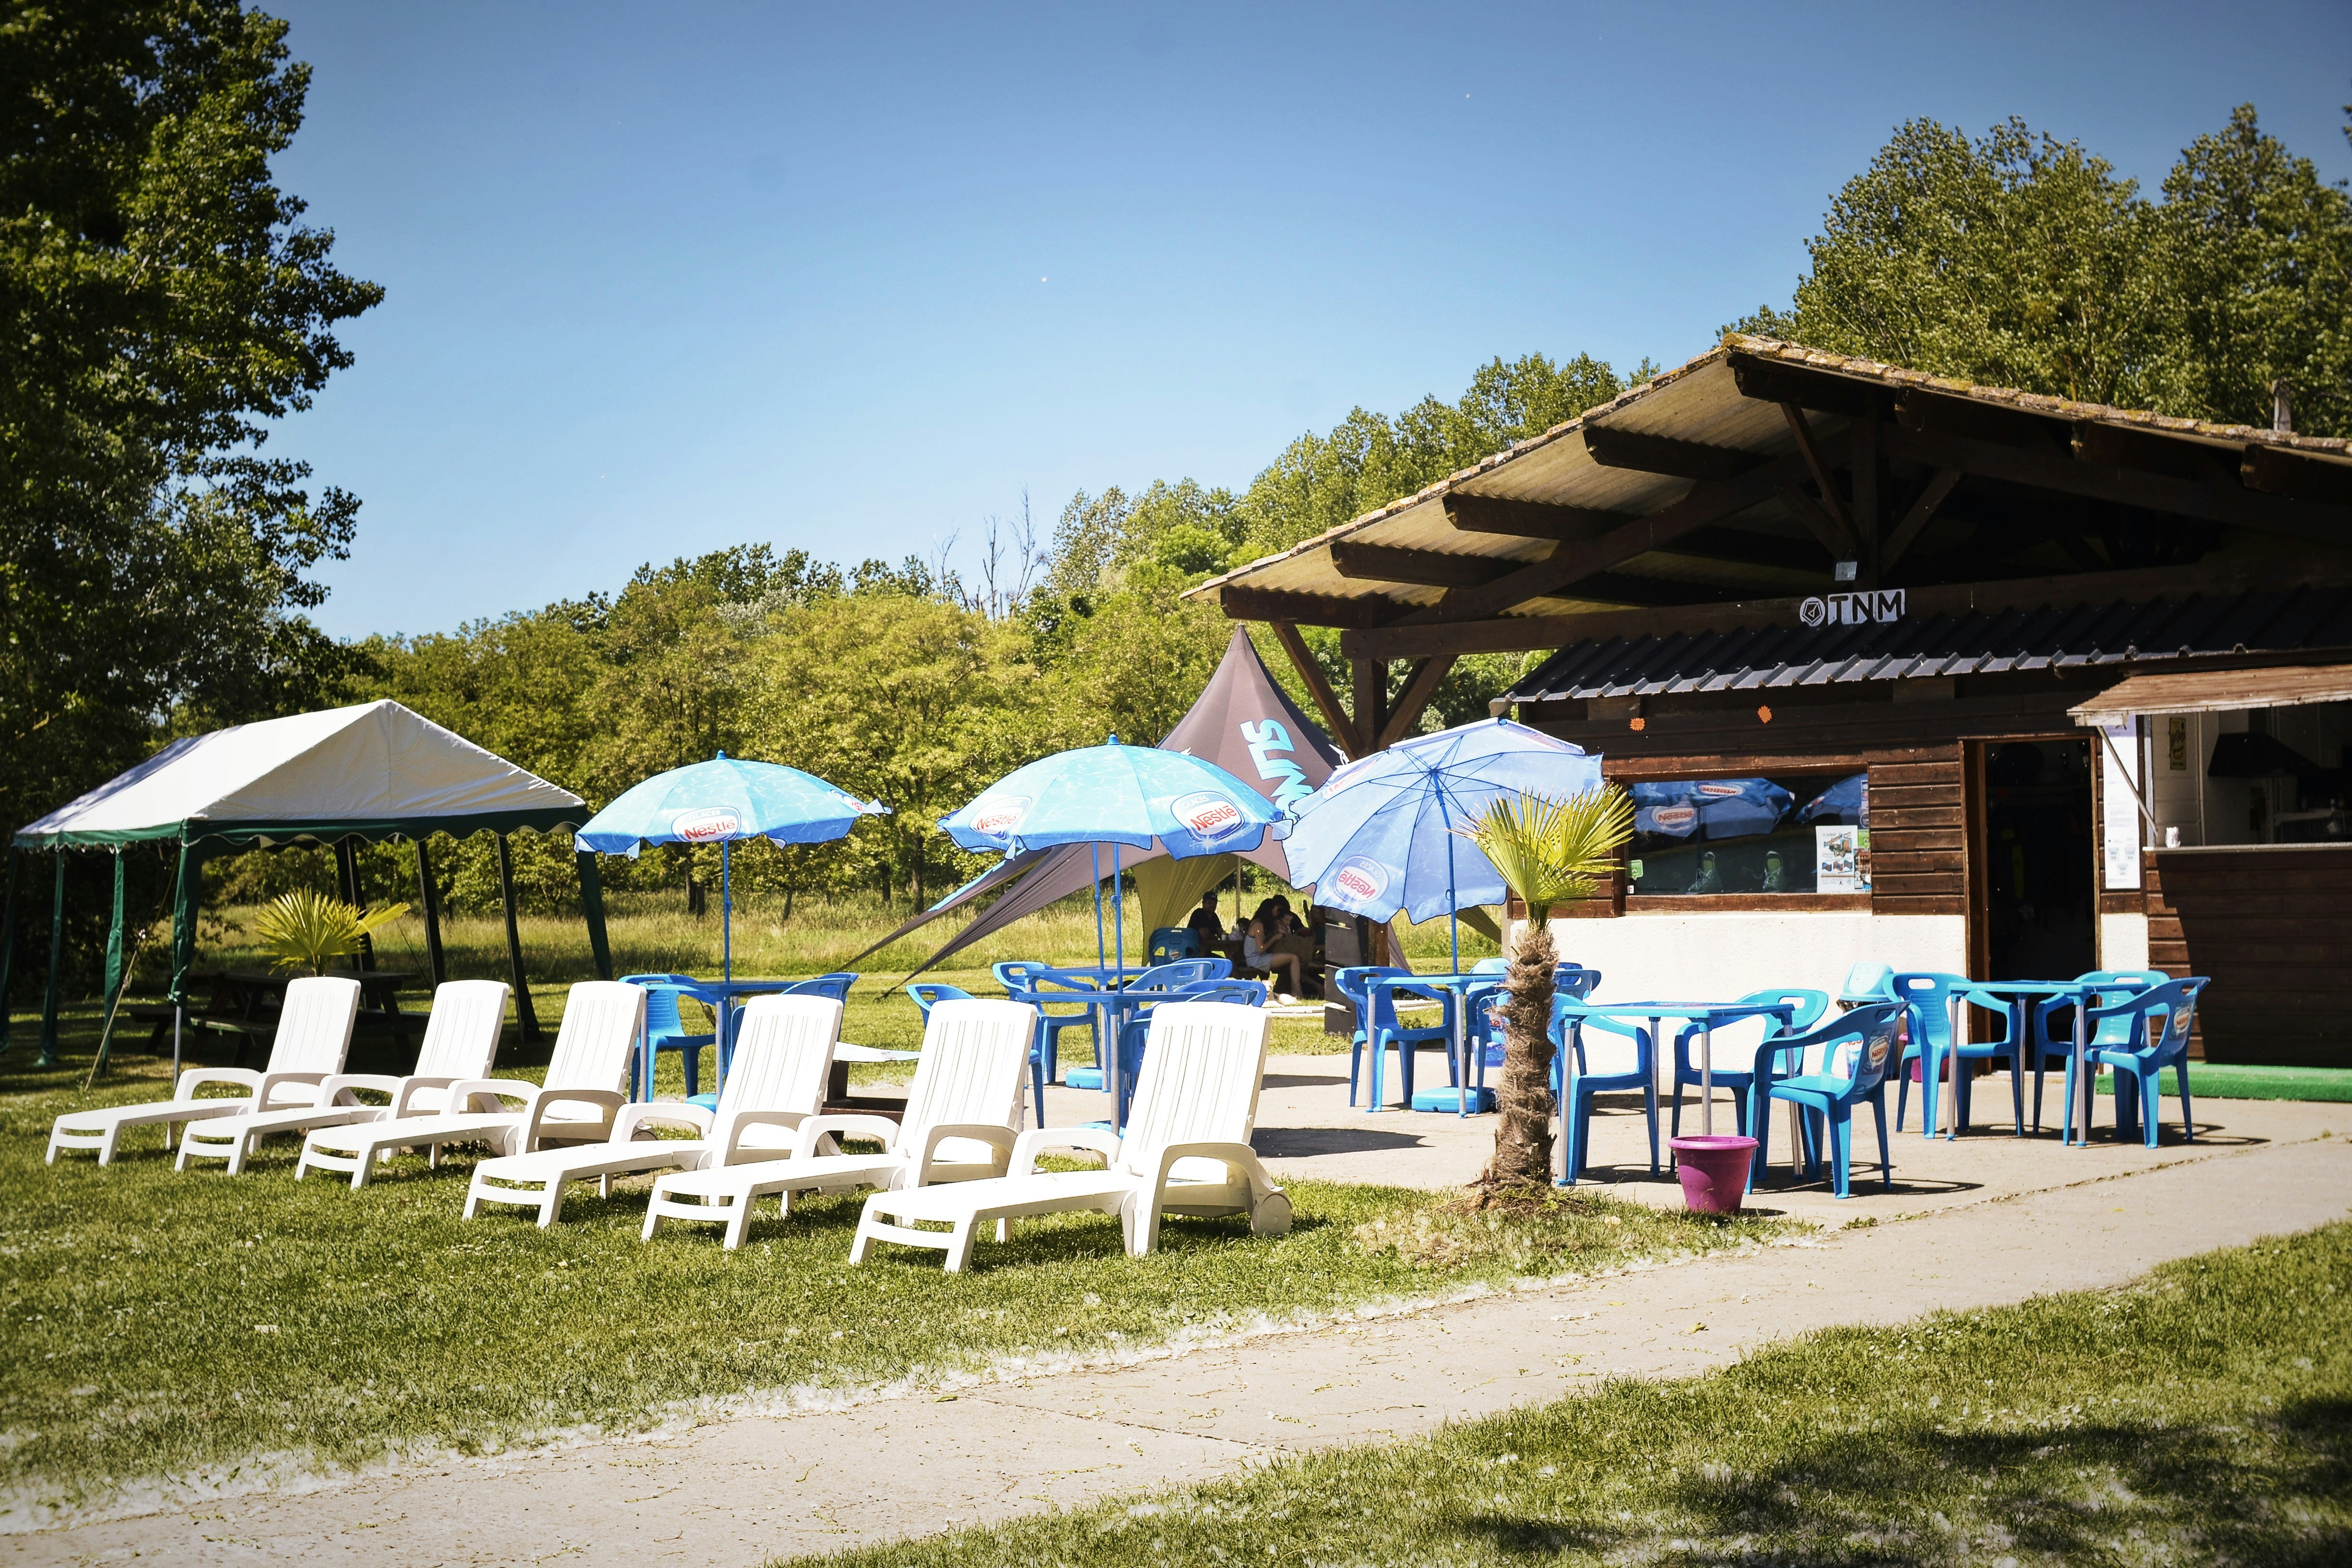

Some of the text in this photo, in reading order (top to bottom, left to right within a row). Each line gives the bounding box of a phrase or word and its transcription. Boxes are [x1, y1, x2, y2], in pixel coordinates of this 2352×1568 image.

[1182, 796, 1210, 808] GLACES
[688, 809, 721, 820] GLACES
[1190, 805, 1237, 831] Nestlé
[684, 820, 735, 839] Nestlé
